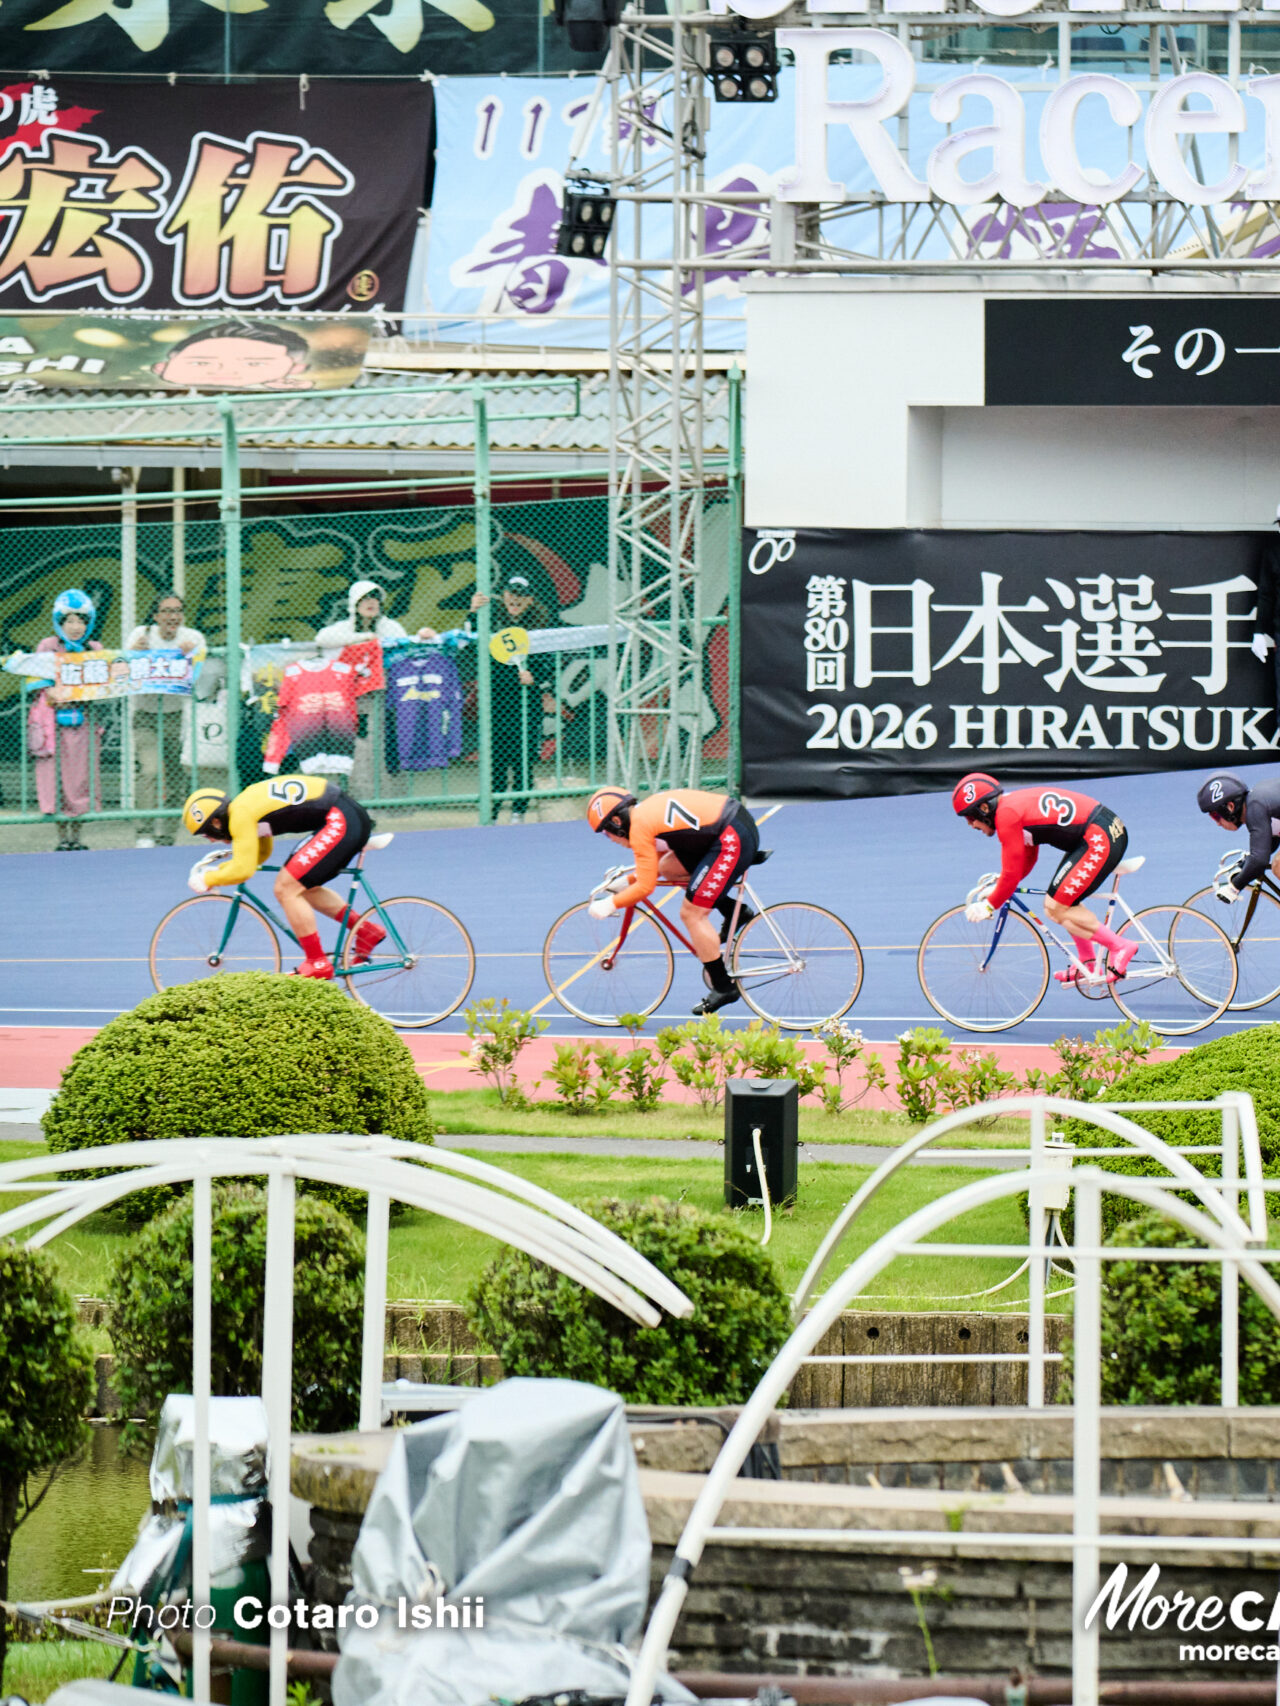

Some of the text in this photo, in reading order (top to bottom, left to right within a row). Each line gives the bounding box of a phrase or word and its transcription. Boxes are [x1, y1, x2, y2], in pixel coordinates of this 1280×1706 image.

[0, 131, 354, 304] 宏佑
[502, 633, 516, 652] 5
[803, 574, 850, 693] 第80回
[805, 703, 938, 750] 2026
[268, 779, 307, 805] 5
[964, 783, 976, 804] 3
[1210, 781, 1223, 803] 2
[190, 803, 205, 823] 5
[664, 798, 700, 831] 7
[1038, 791, 1077, 827] 3
